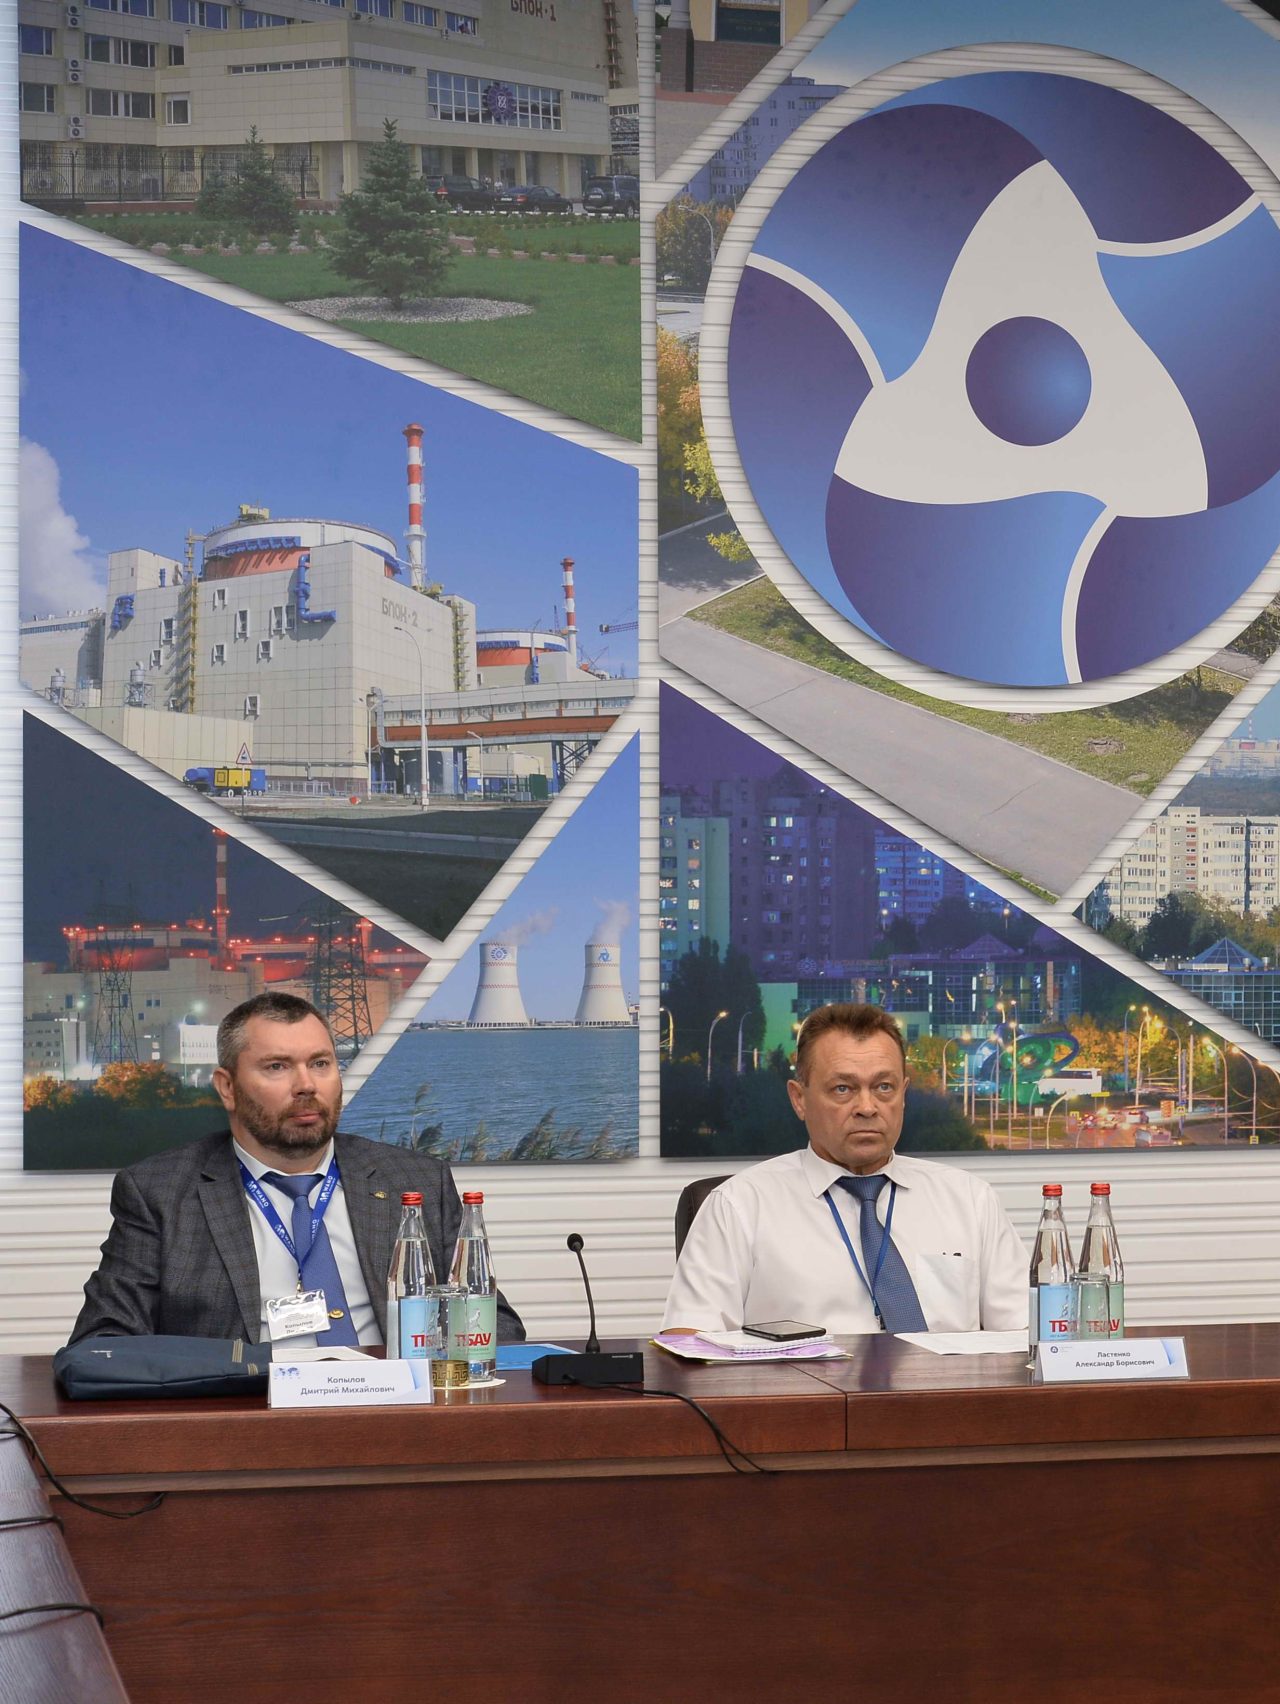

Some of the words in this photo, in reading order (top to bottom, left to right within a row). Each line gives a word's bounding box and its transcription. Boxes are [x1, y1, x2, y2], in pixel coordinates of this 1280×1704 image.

[255, 1189, 269, 1207] WANO
[1075, 1360, 1114, 1368] Александр
[1116, 1359, 1155, 1367] Борисович
[327, 1376, 366, 1384] Копылов
[300, 1386, 339, 1396] Дмитрий
[341, 1385, 395, 1394] Михайлович
